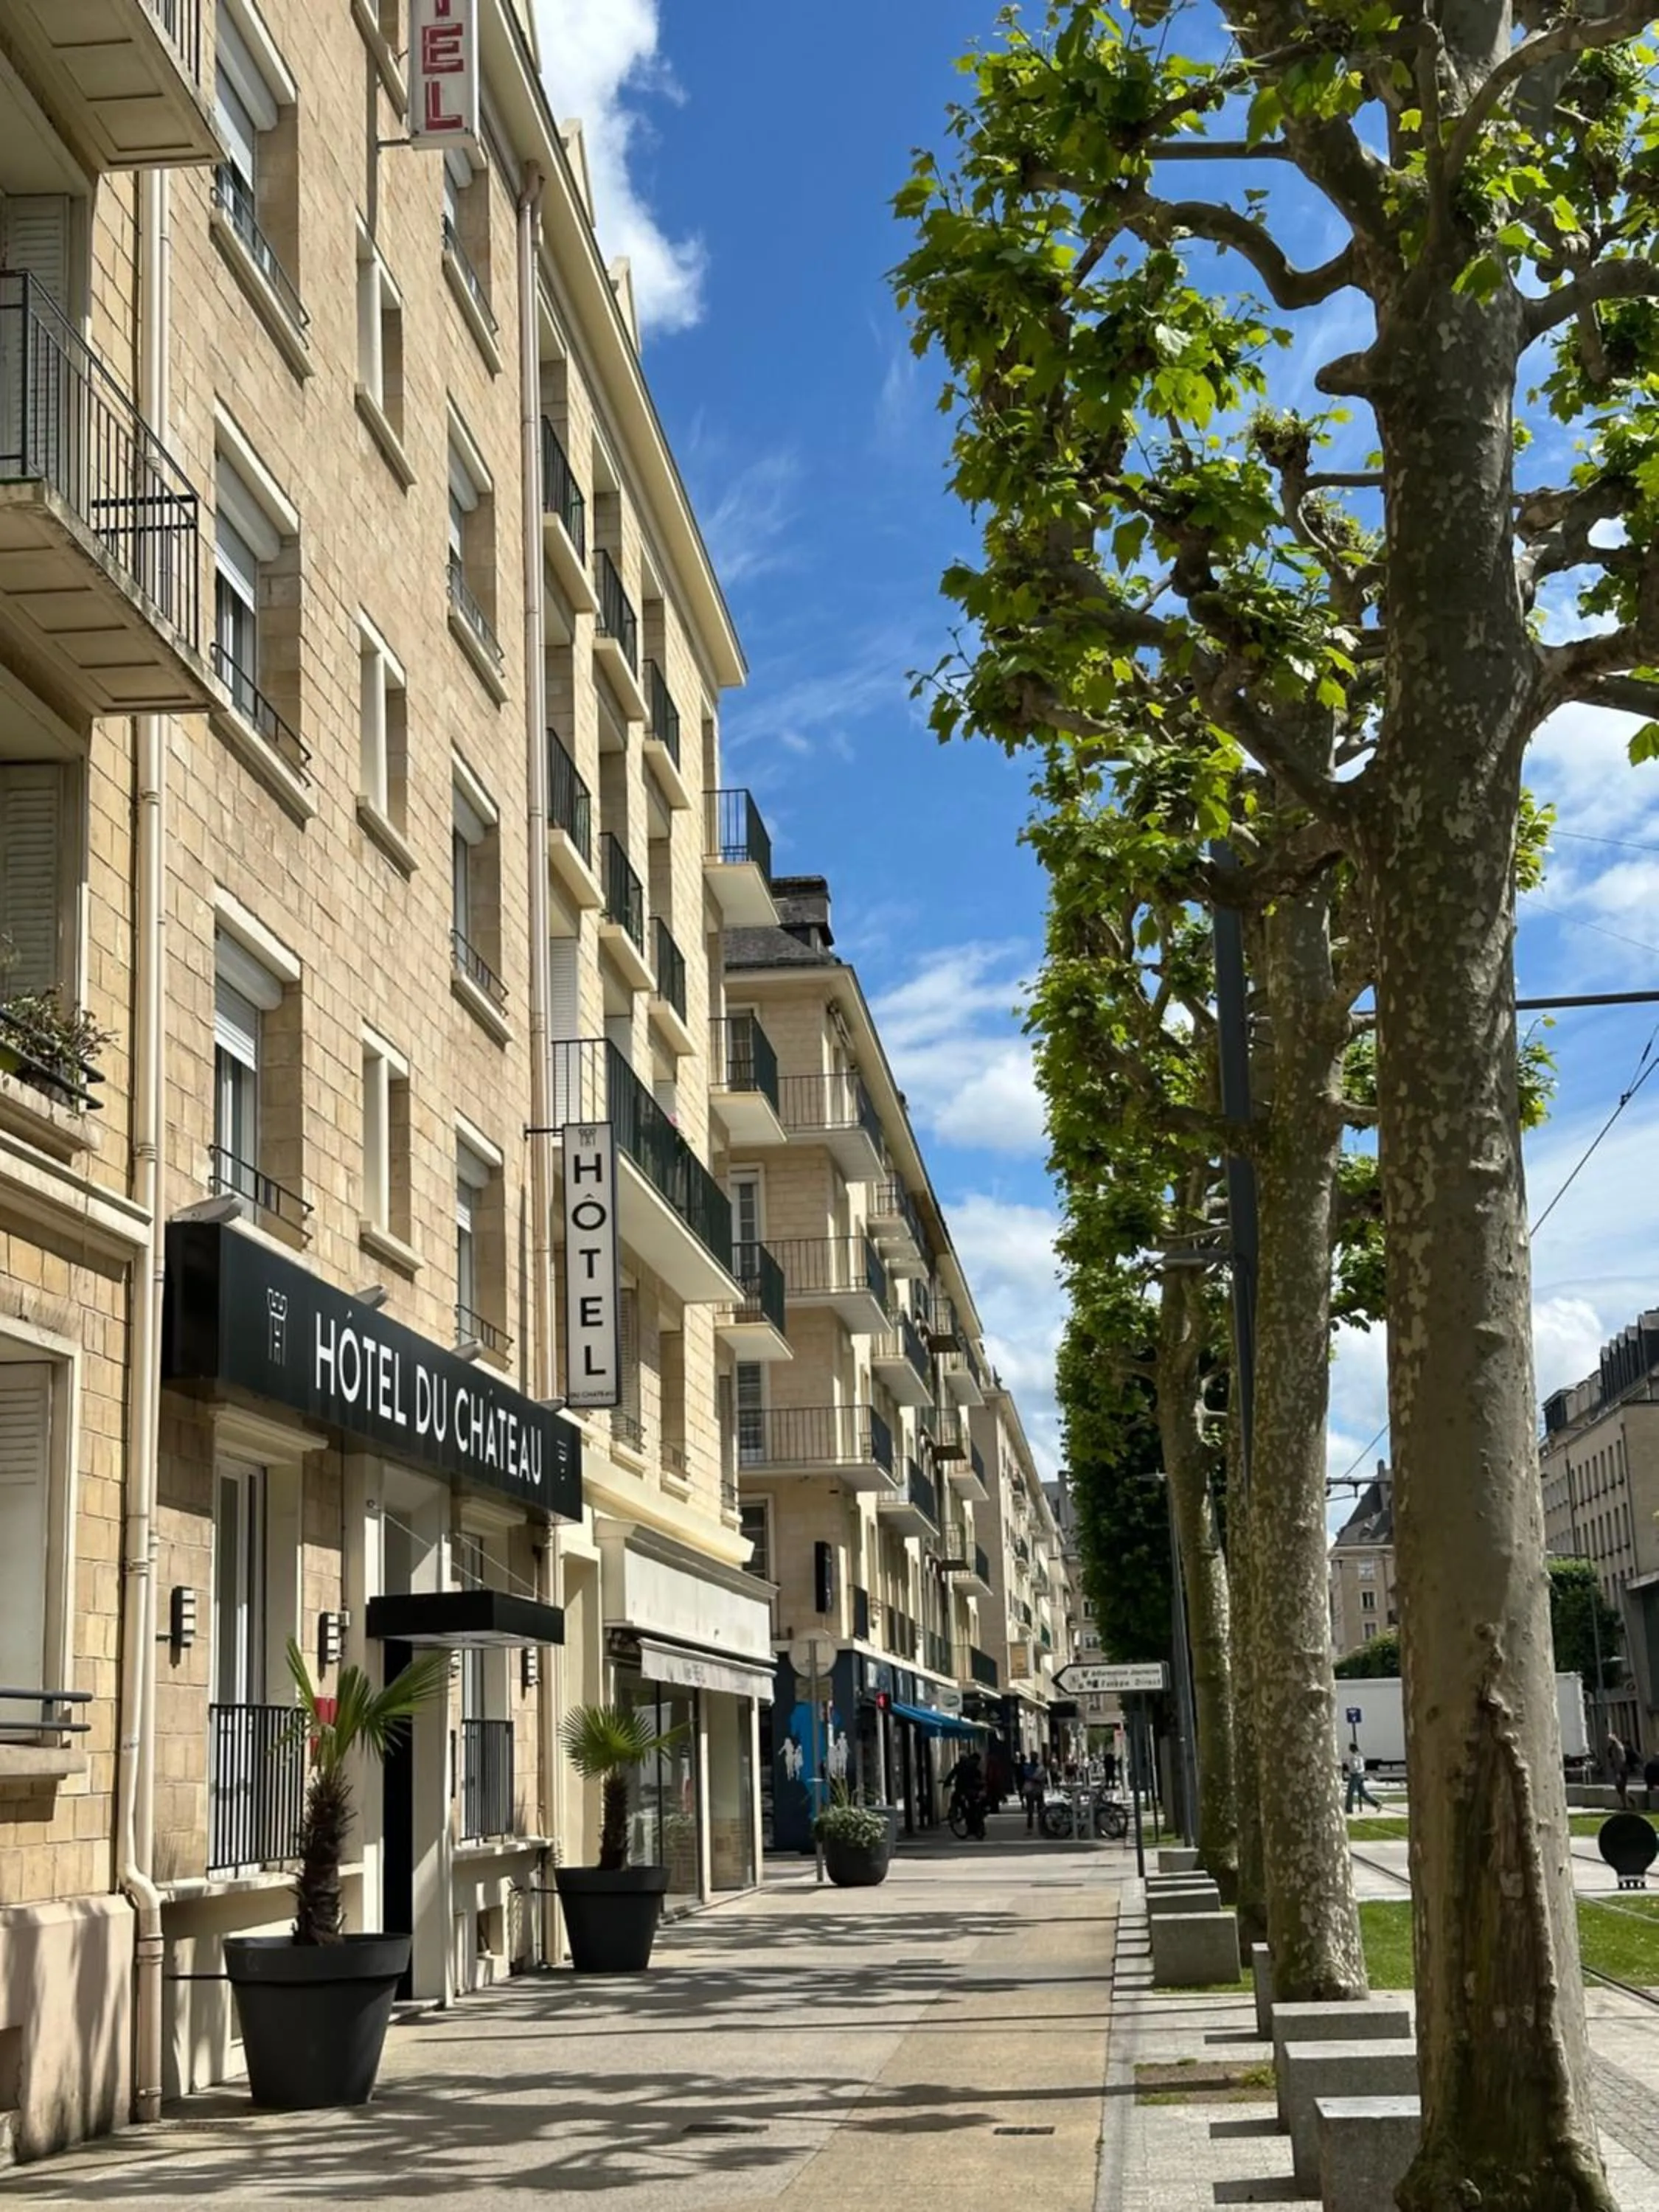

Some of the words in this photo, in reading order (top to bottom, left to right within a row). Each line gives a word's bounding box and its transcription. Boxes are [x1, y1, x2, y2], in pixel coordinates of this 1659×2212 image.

[571, 1153, 607, 1376] HÔTEL
[315, 1310, 407, 1427] HÔTEL
[415, 1364, 448, 1442] DU
[454, 1387, 542, 1486] CHÂTEAU
